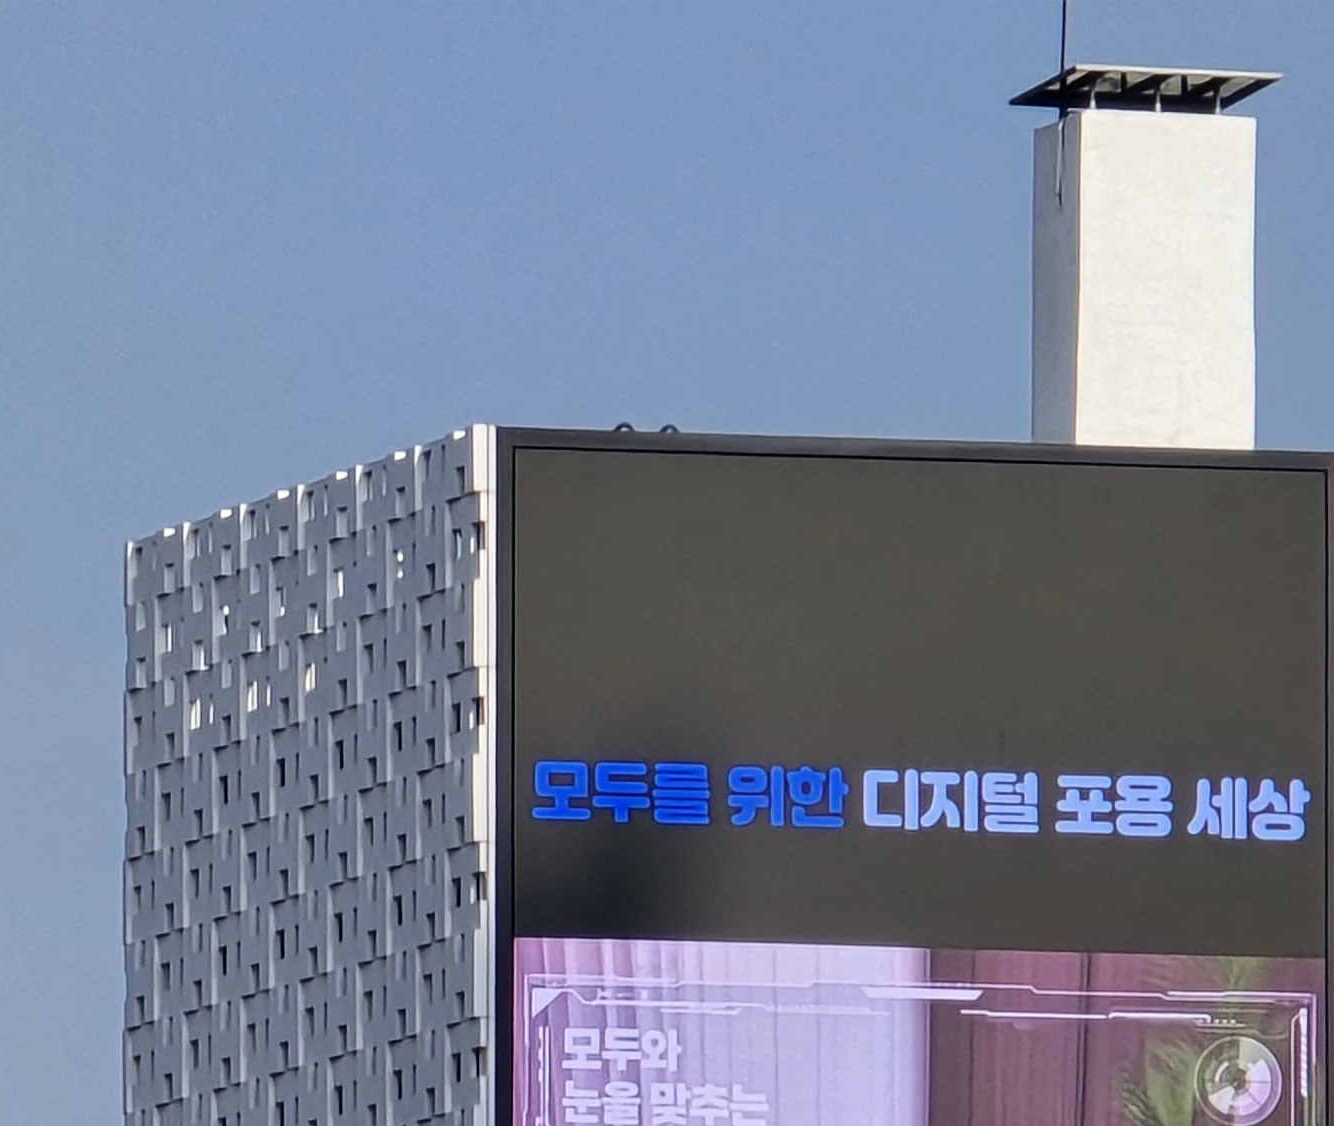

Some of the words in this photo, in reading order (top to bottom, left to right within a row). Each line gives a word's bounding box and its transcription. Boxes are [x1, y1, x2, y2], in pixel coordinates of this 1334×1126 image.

[532, 762, 710, 824] 모두를
[727, 766, 848, 828] 위한
[862, 769, 1040, 834] 디지털
[1055, 774, 1173, 837] 포용
[1187, 777, 1311, 841] 세상
[562, 1027, 681, 1072] 모두와
[562, 1081, 640, 1126] 눈을
[650, 1082, 768, 1126] 맞추는
